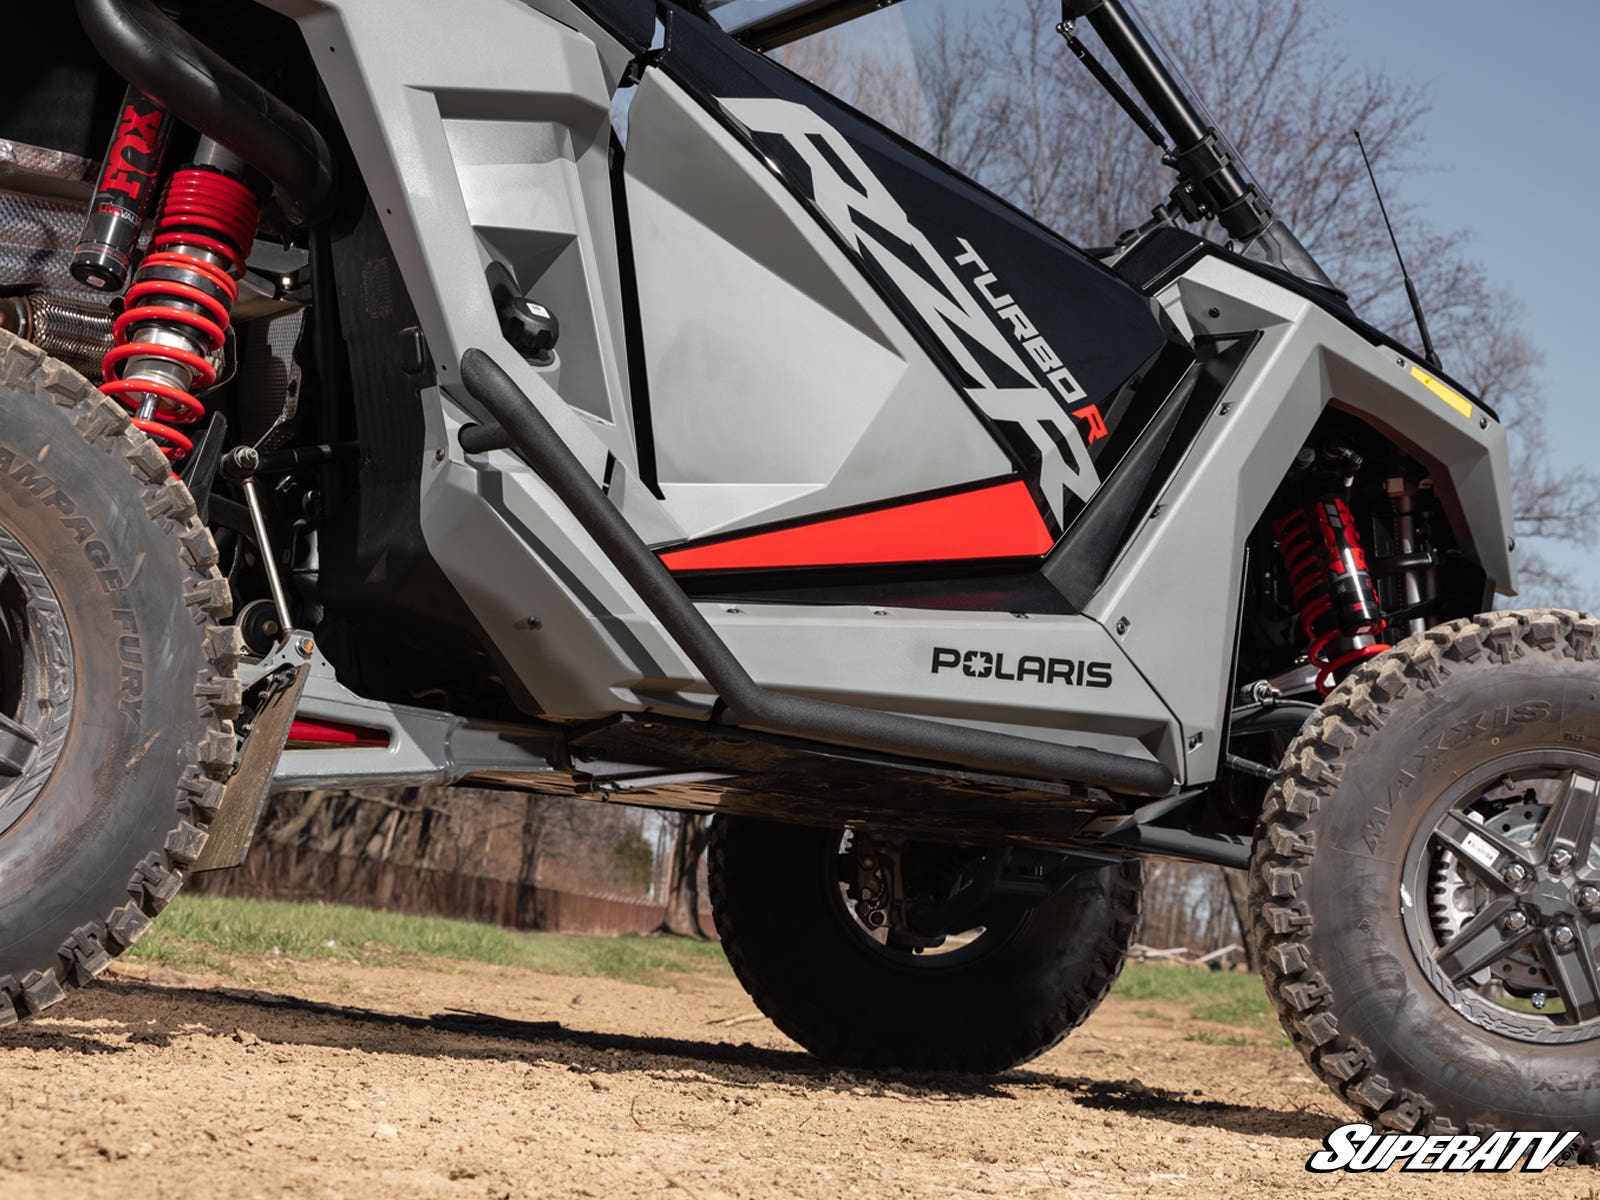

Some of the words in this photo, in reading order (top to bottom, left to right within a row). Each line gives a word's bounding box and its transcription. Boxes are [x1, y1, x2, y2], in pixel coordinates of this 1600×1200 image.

[100, 104, 163, 200] FOX
[716, 97, 1101, 533] RZR
[954, 236, 1088, 404] TURBO
[1072, 404, 1108, 445] R
[111, 608, 144, 727] FURY
[931, 647, 1112, 688] POLARIS
[1361, 700, 1552, 855] MAXXIS
